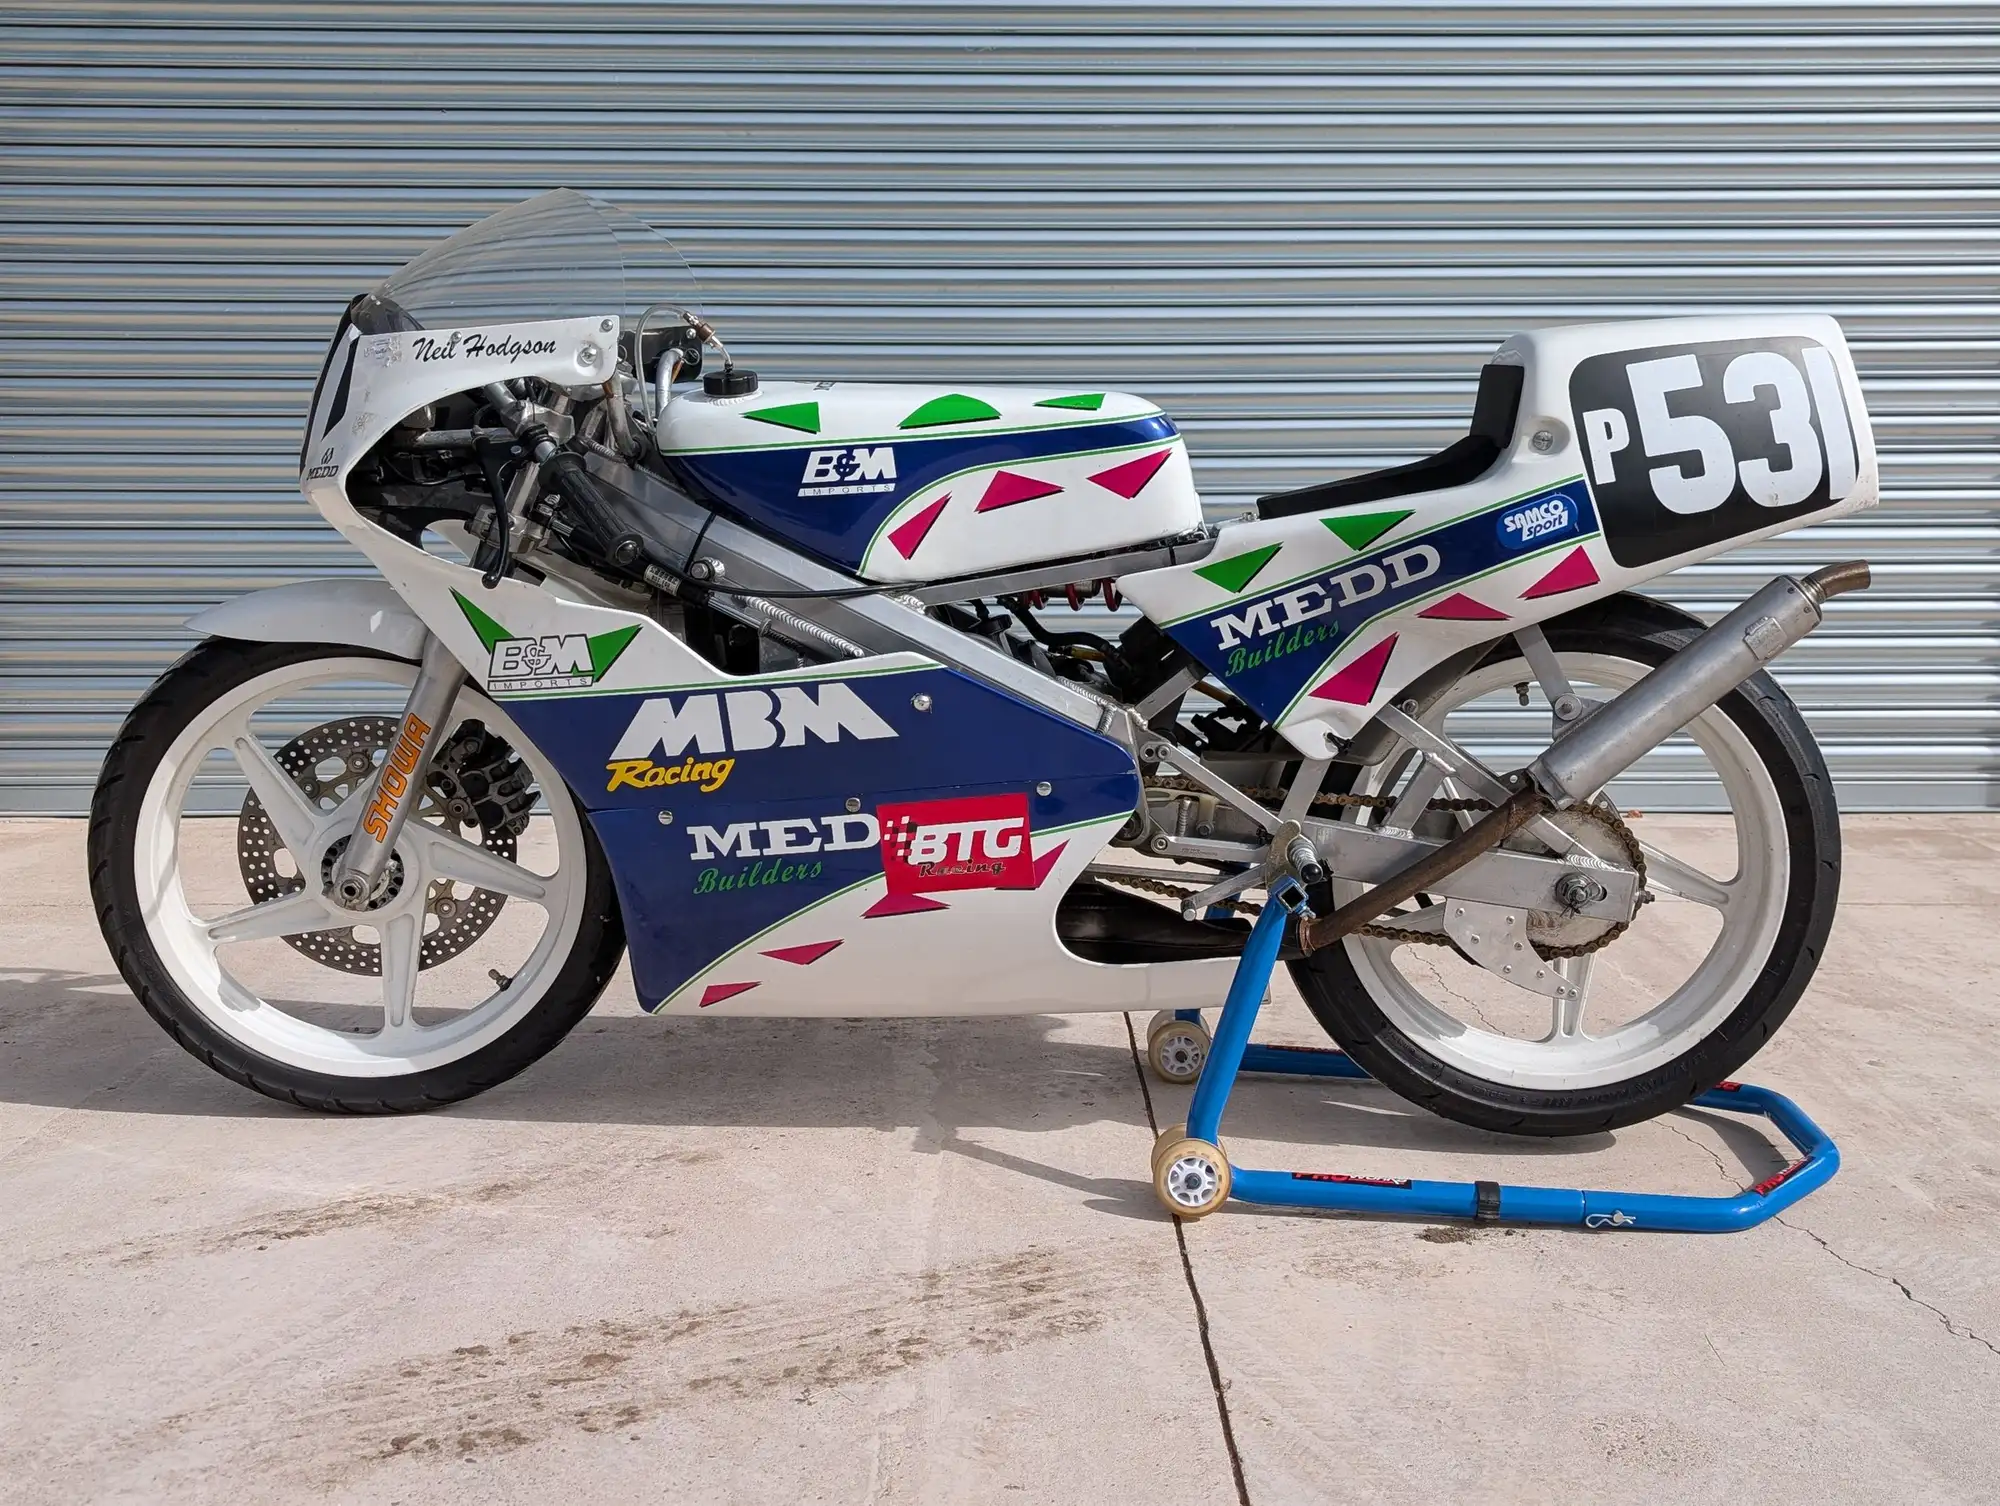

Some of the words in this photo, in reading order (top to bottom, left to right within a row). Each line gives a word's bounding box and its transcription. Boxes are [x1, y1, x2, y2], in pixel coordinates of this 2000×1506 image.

[412, 337, 457, 362] Neil
[463, 333, 557, 363] Hodgson
[306, 464, 339, 481] MEDD
[801, 447, 897, 484] B&M
[802, 483, 893, 497] IMPORTS
[1503, 499, 1564, 533] SAMCO
[1526, 511, 1564, 540] sport
[1210, 544, 1441, 651] MEDD
[488, 633, 596, 679] B&M
[1224, 620, 1341, 678] Builders
[493, 677, 588, 690] IMPORTS
[608, 682, 900, 761] MBM
[363, 712, 432, 844] SHOWA
[605, 756, 736, 793] Racing
[686, 813, 882, 861] MED
[907, 817, 1025, 866] BTG
[693, 858, 823, 895] Builders
[918, 858, 1006, 878] Racing
